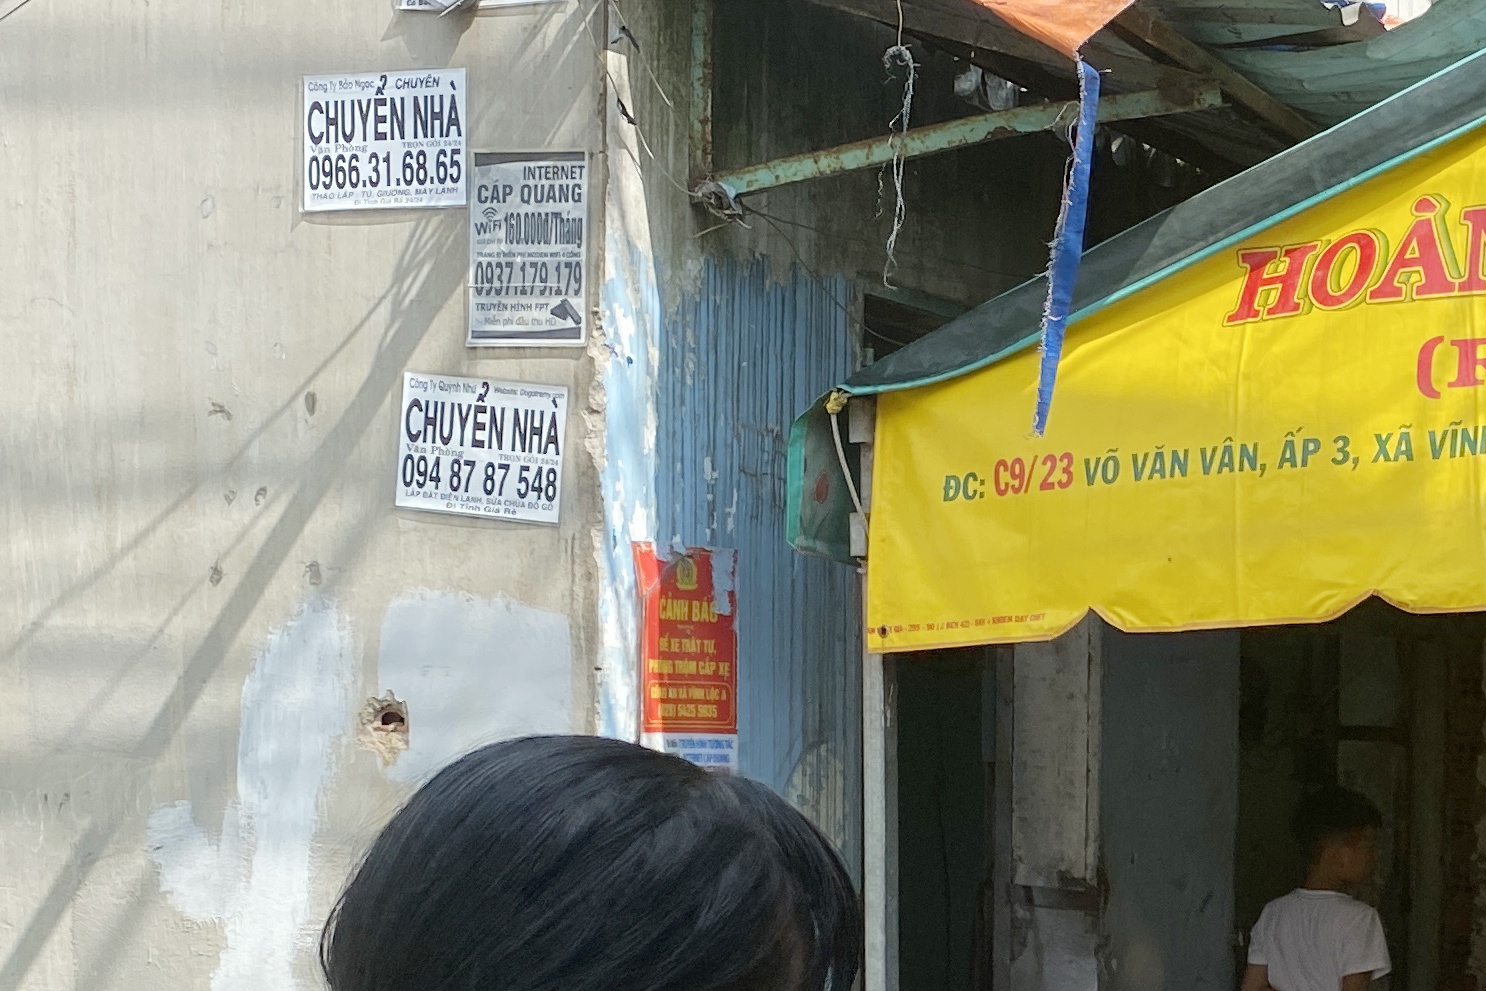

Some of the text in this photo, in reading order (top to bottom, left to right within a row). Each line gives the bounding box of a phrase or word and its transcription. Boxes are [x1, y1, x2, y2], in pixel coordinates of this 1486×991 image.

[307, 74, 462, 145] CHUYỂN NHÀ
[308, 148, 462, 191] 0966.31.68.65
[523, 165, 585, 181] INTERNET
[477, 178, 582, 205] CÁP QUANG
[475, 261, 582, 296] 0937.179.179
[535, 302, 550, 311] FPT
[405, 381, 560, 456] CHUYỂN NHÀ
[431, 445, 465, 460] Phòng
[943, 472, 986, 502] ĐC:
[993, 451, 1075, 497] C9/23
[1085, 447, 1120, 487] VÕ
[1131, 443, 1190, 483] VĂN
[1200, 436, 1268, 477] VÂN,
[1277, 425, 1321, 471] ẤP
[1330, 434, 1360, 471] 3,
[1371, 423, 1415, 464] XÃ
[402, 453, 557, 502] 094 87 87 548
